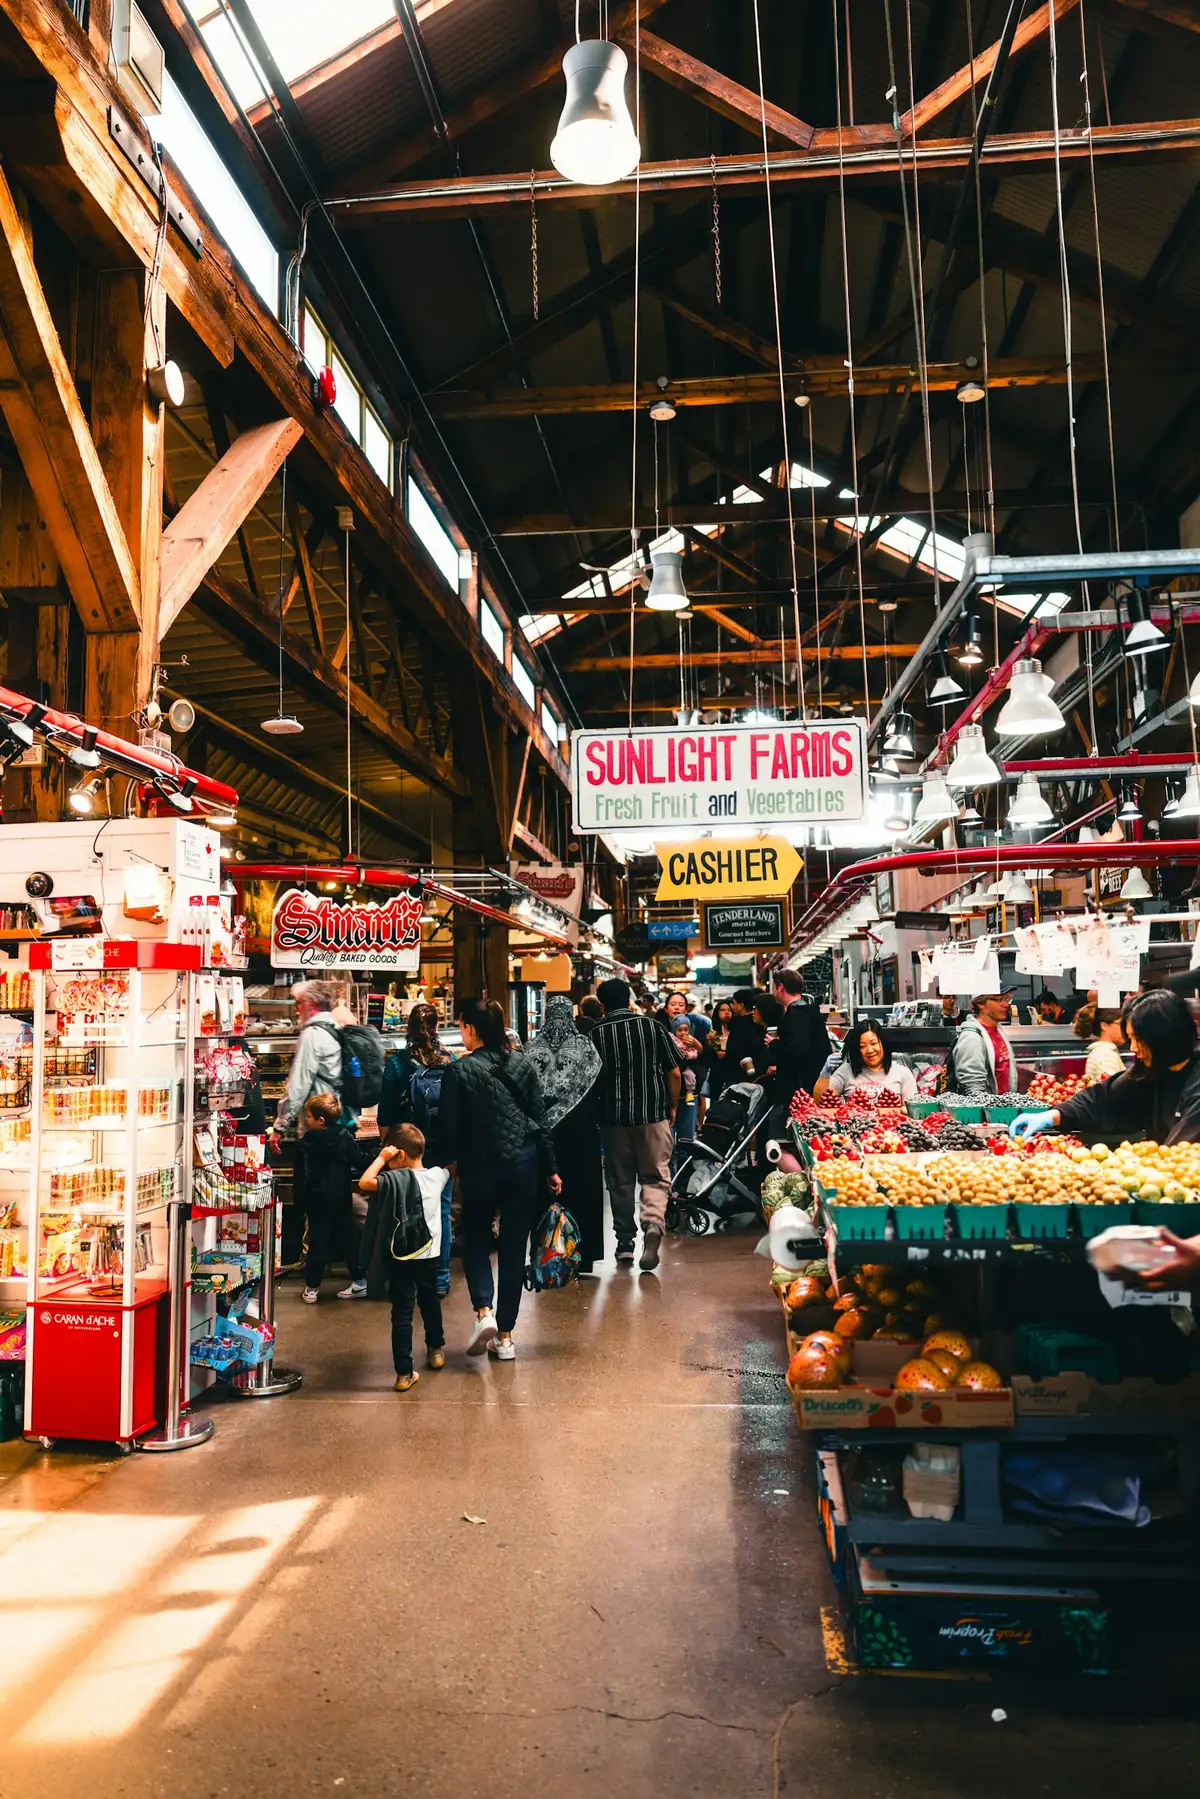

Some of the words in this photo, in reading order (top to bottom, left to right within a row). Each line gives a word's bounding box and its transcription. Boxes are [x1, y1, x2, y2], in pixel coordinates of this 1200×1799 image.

[586, 735, 737, 786] SUNLIGHT
[750, 730, 853, 780] FARMS
[595, 793, 642, 821] Fresh
[651, 792, 698, 819] Fruit
[708, 790, 737, 817] and
[746, 788, 844, 816] Vegetables
[668, 847, 778, 886] CASHIER
[280, 895, 423, 948] Stuart's
[712, 908, 775, 924] TENDERLAND
[731, 920, 756, 928] meats
[103, 947, 120, 957] CHE
[300, 946, 337, 967] Quality
[339, 953, 366, 963] BAKED
[369, 954, 398, 964] GOODS
[54, 1313, 84, 1325] CARAN
